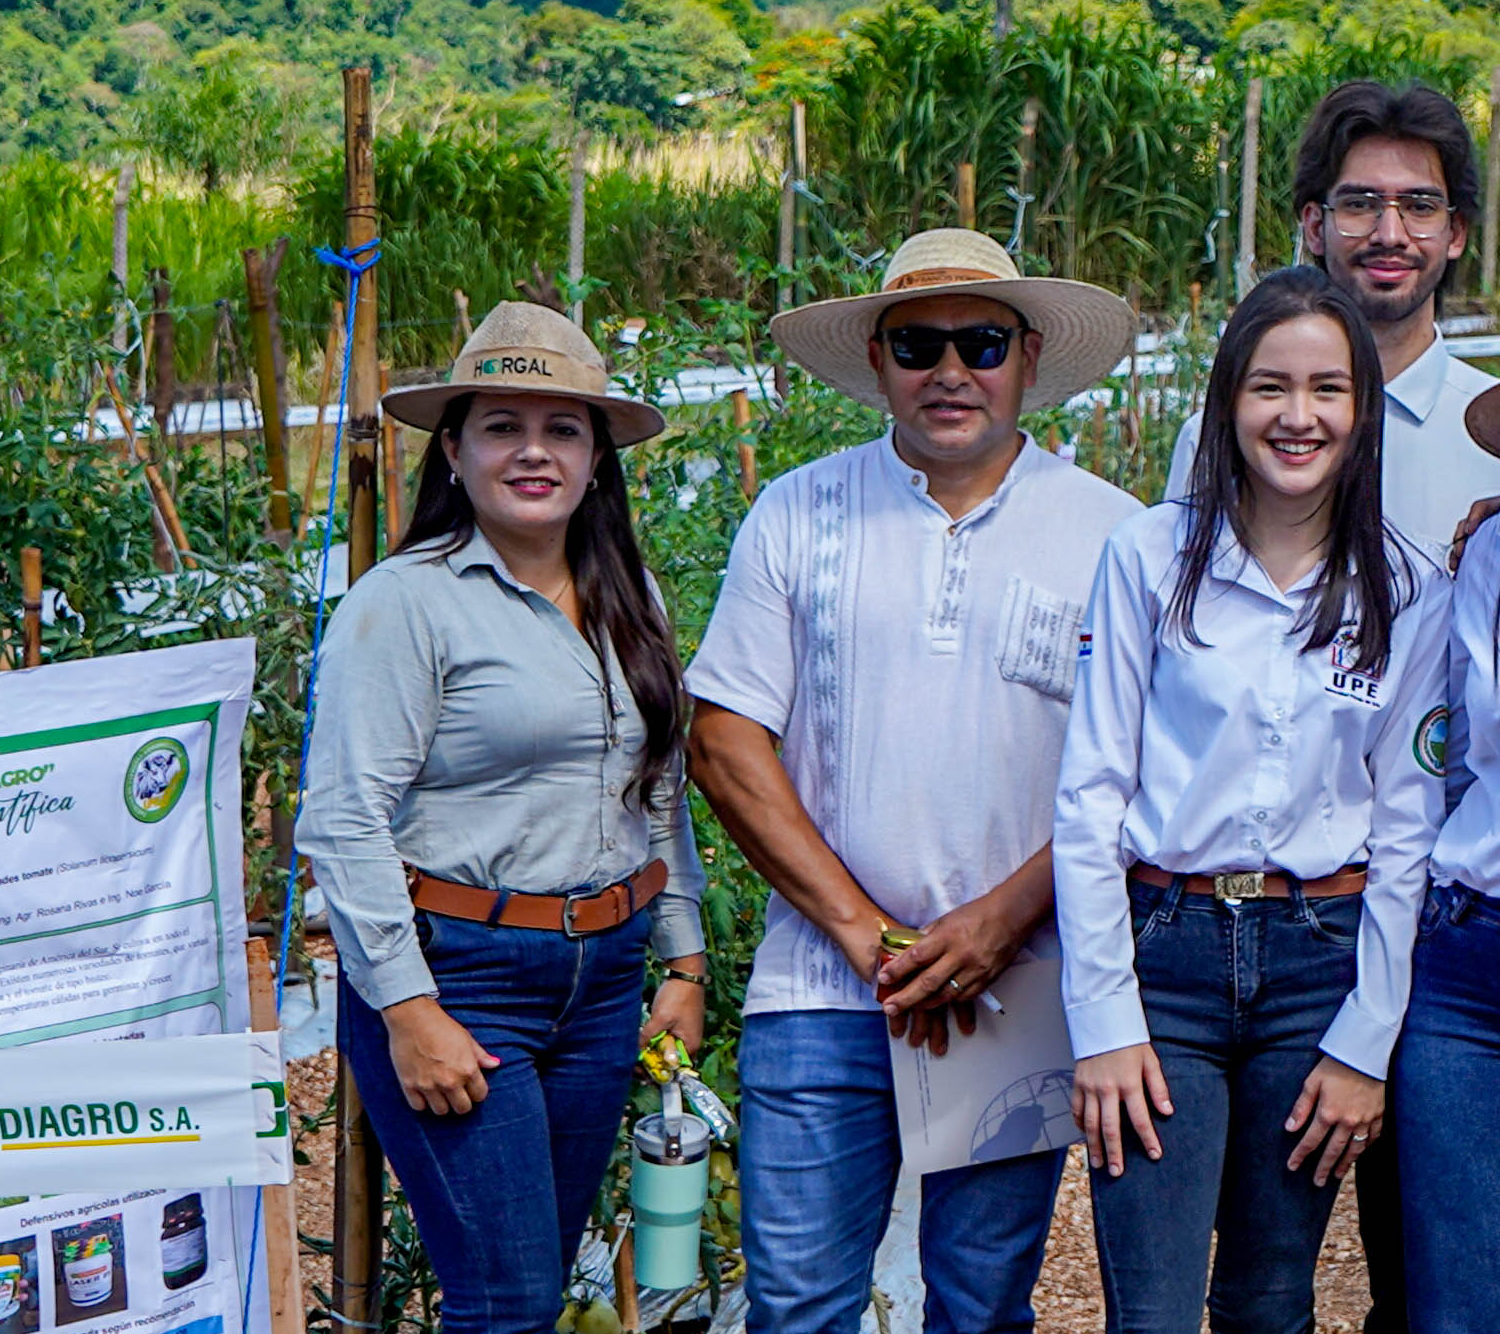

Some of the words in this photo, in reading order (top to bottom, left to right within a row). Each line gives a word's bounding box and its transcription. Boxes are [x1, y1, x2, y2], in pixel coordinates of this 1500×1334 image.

[1333, 672, 1379, 699] UPE
[22, 866, 54, 881] tomate
[149, 1107, 200, 1131] S.A.
[20, 1209, 74, 1227] Defensivos
